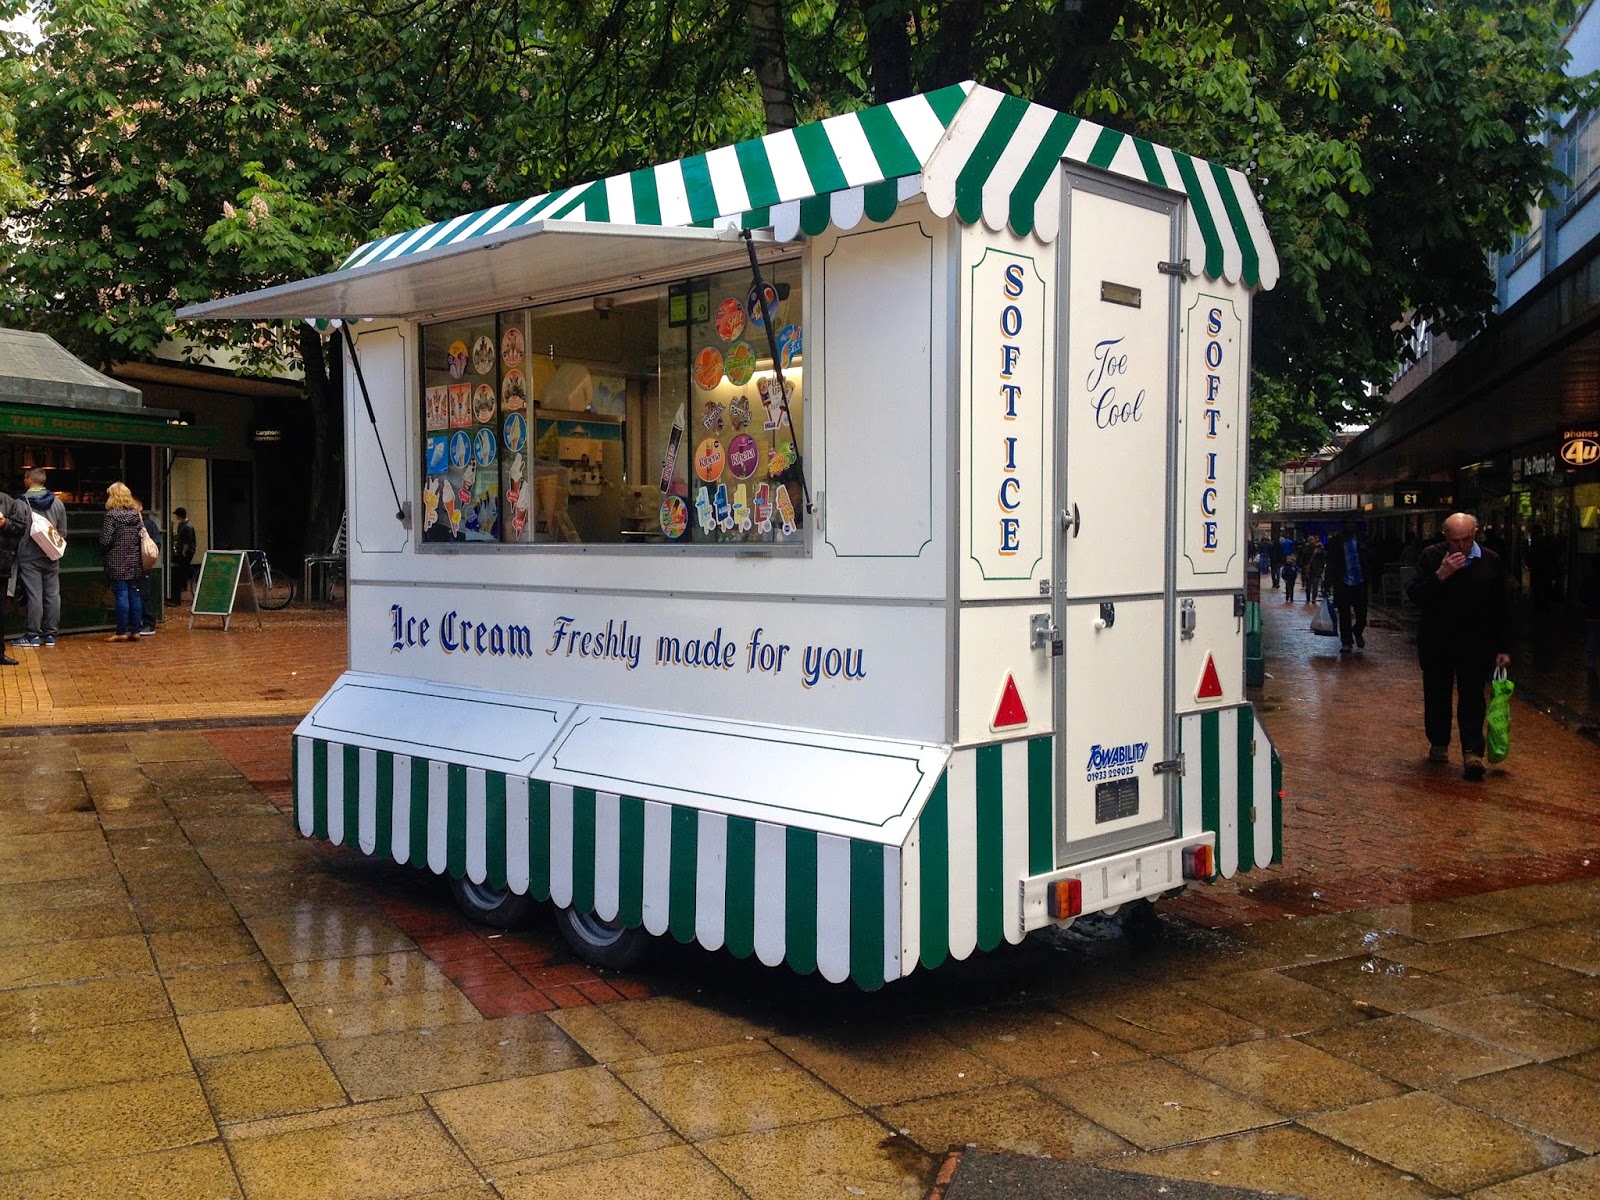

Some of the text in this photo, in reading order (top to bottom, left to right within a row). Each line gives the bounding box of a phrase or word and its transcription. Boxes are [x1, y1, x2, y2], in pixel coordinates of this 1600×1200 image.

[998, 264, 1024, 556] SOFT ICE
[1091, 386, 1146, 430] Cool
[1201, 308, 1223, 553] SOFT ICE
[1564, 431, 1599, 439] phones
[699, 453, 722, 469] Ribena
[730, 448, 756, 467] Ribena
[1565, 441, 1598, 464] 4u
[1403, 493, 1418, 504] £1
[391, 604, 867, 690] Ice Cream Freshly made for you
[1087, 742, 1148, 771] TOWABILITY
[1087, 766, 1134, 782] 01933 229025
